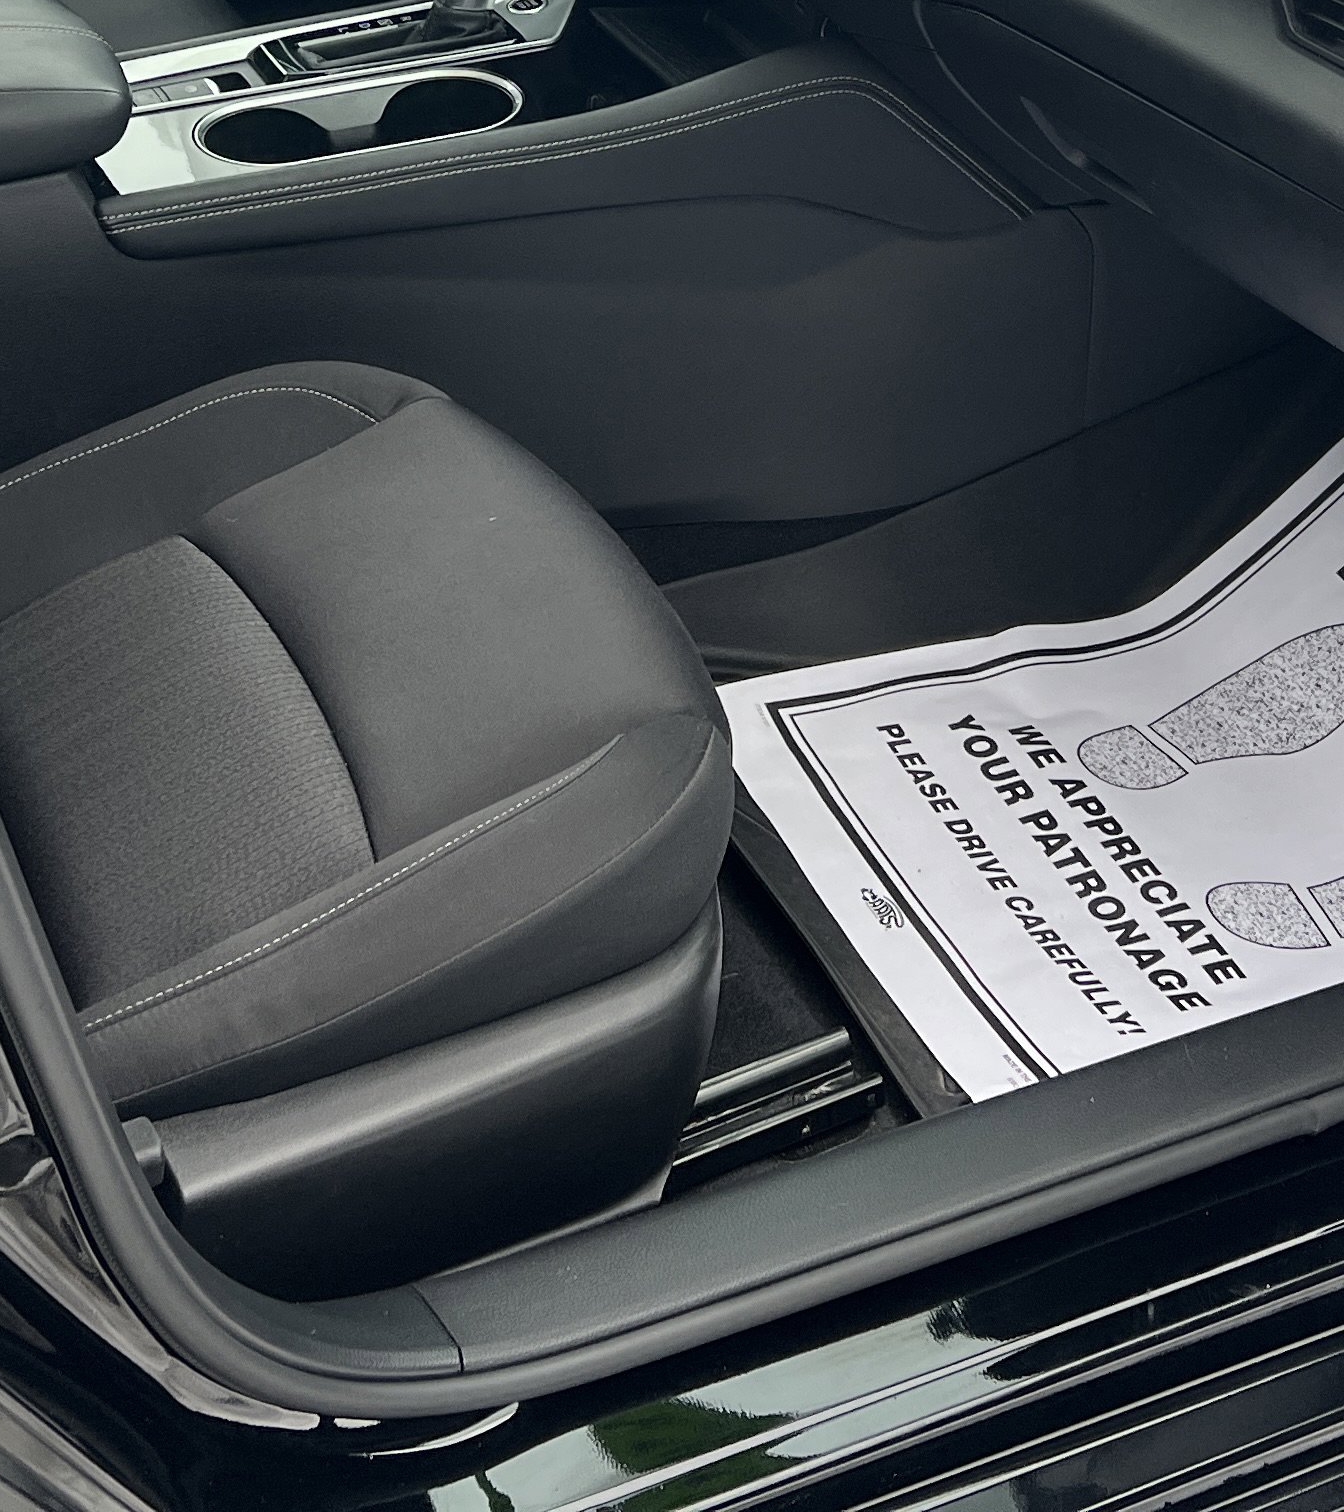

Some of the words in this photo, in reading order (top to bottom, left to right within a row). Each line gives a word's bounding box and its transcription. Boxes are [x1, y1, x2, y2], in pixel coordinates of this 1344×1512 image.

[876, 723, 960, 813] PLEASE
[943, 818, 1018, 891] DRIVE
[1005, 896, 1148, 1036] CAREFULLY!
[948, 714, 1034, 807] YOUR
[1018, 809, 1212, 1012] PATRONAGE
[1008, 724, 1068, 769] WE
[1048, 778, 1247, 985] APPRECIATE
